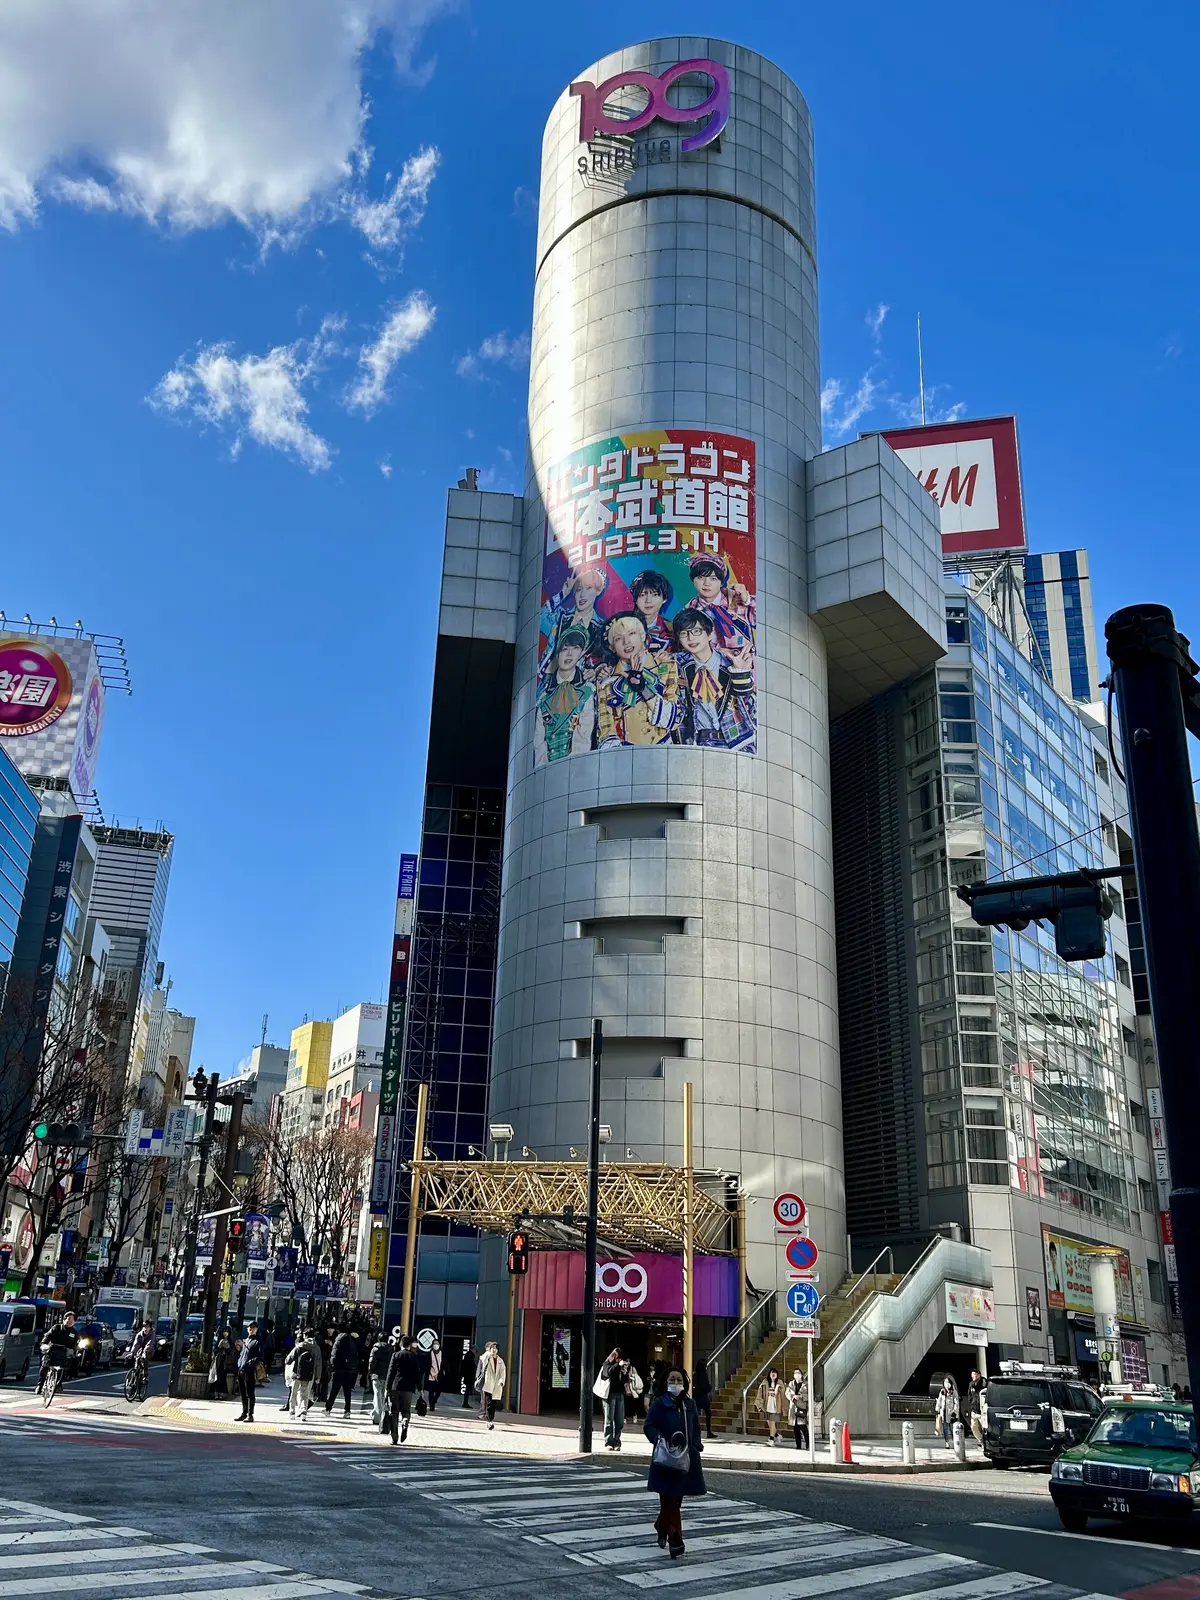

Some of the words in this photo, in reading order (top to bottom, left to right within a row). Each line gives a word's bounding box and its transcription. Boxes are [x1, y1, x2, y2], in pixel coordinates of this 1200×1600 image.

[569, 58, 731, 153] 109
[545, 478, 749, 556] 日本武道館
[568, 529, 719, 568] 2025.3.14
[402, 859, 415, 877] THE
[400, 877, 414, 897] PRIME
[384, 1001, 402, 1104] ビリヤード・ダーツ
[171, 1108, 186, 1152] 道玄坂下
[780, 1202, 799, 1217] 30
[594, 1297, 628, 1309] SHIBUYA
[793, 1291, 806, 1313] P
[803, 1303, 812, 1313] 40
